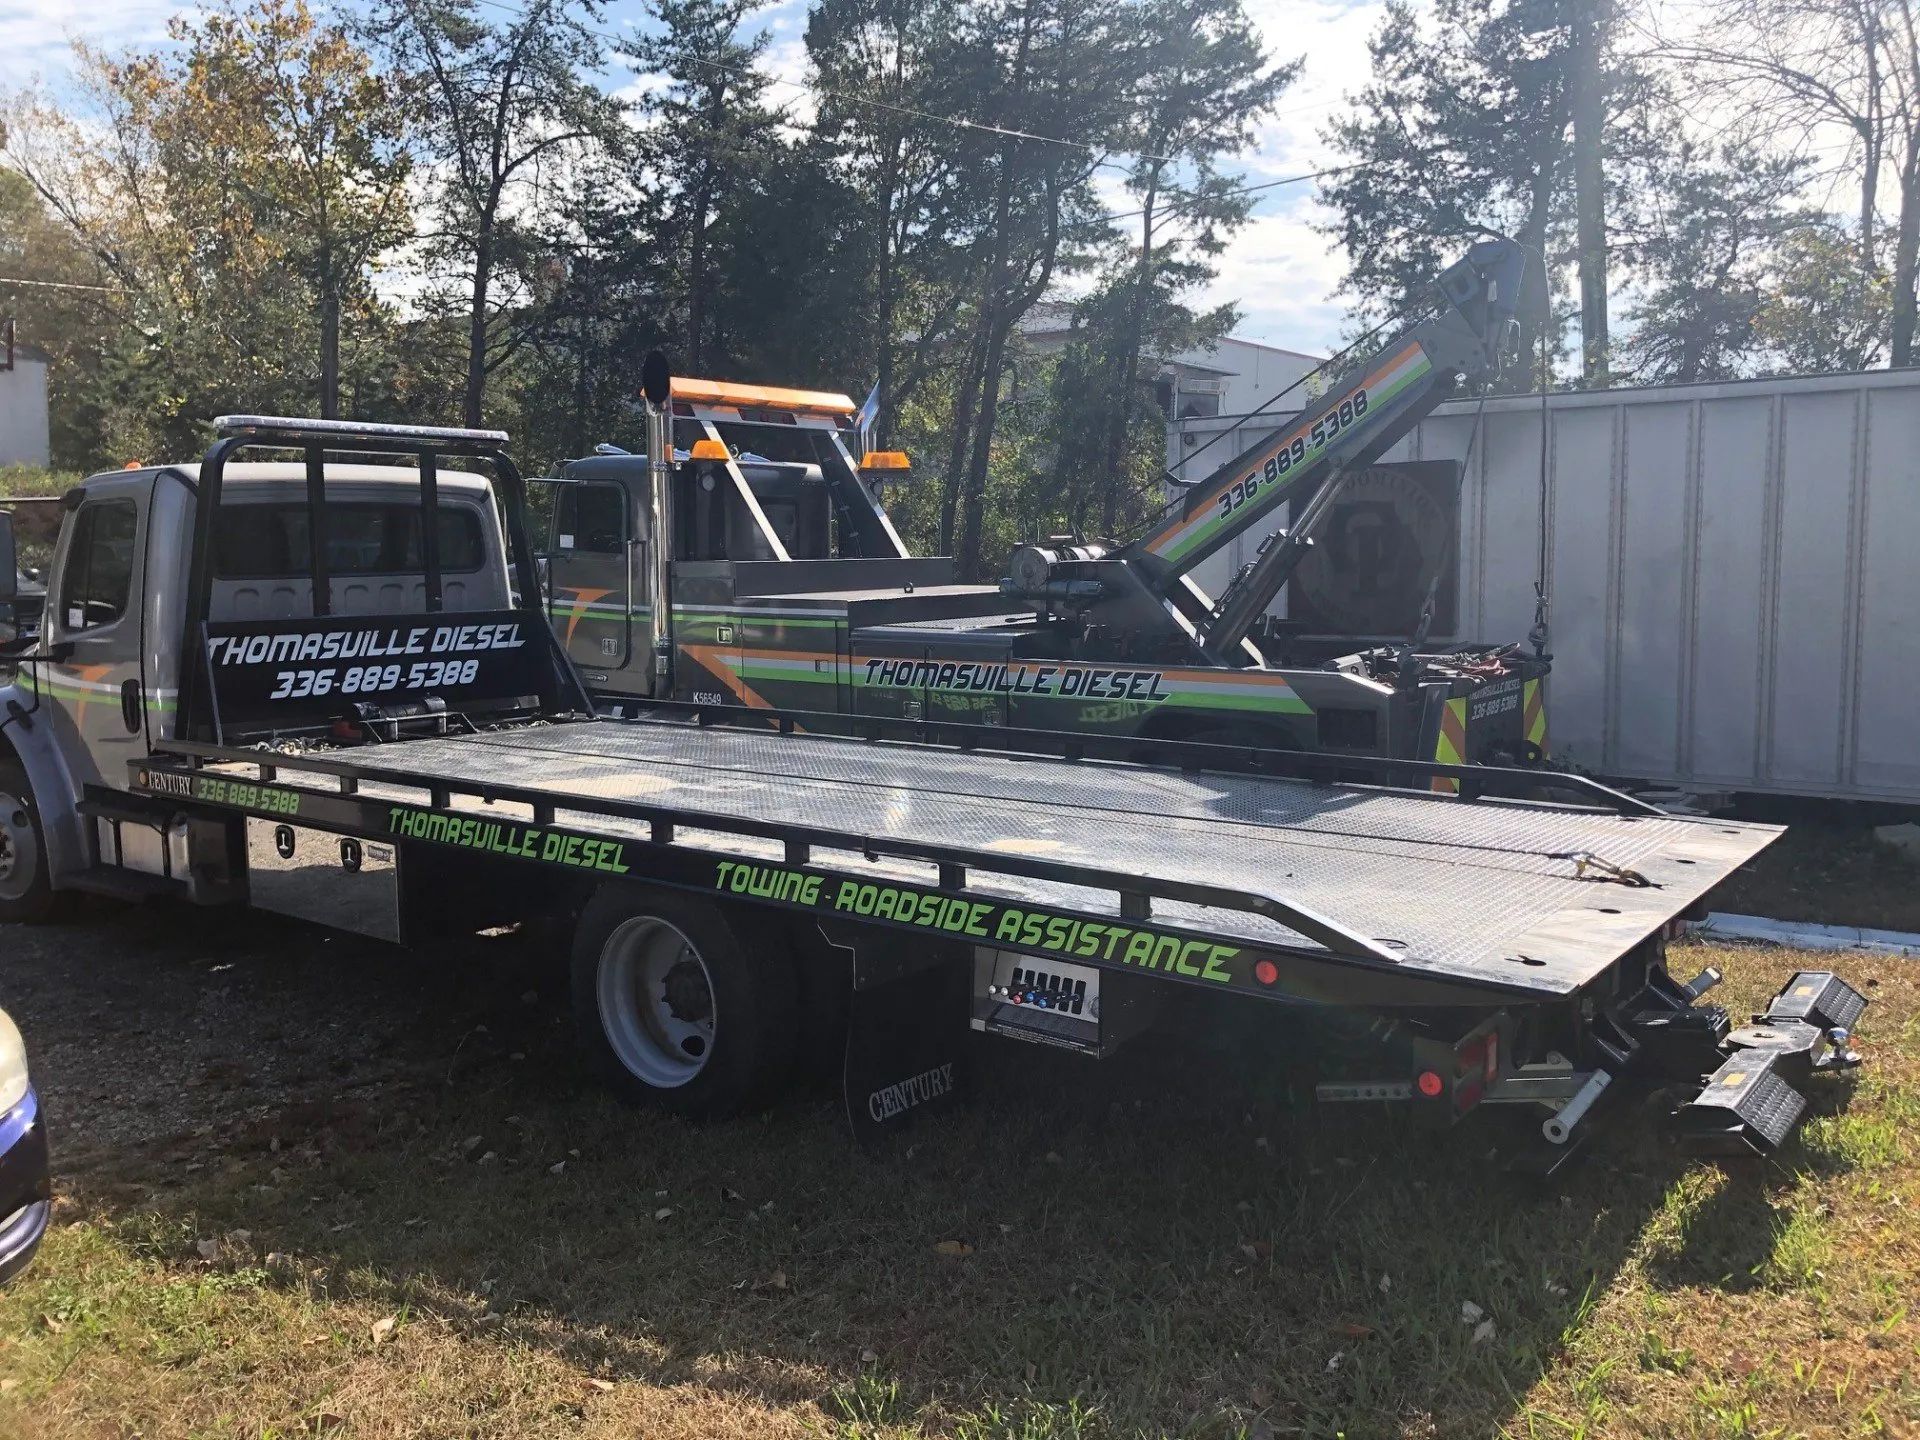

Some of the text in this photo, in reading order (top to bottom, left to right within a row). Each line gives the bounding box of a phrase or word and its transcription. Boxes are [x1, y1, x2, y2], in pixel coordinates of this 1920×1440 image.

[1217, 389, 1368, 520] 336-889-5388
[207, 624, 526, 665] THOMASVILLE DIESEL
[270, 660, 480, 699] 336-889-5388
[693, 692, 722, 705] K56549
[865, 659, 1171, 702] THOMASVILLE DIESEL
[149, 771, 300, 814] CENTURY 336-889-5388
[389, 807, 631, 873] THOMASVILLE DIESEL
[716, 861, 825, 906] TOWING
[836, 881, 996, 936] ROADSIDE
[995, 908, 1242, 983] ASSISTANCE
[868, 1062, 953, 1122] CENTURY
